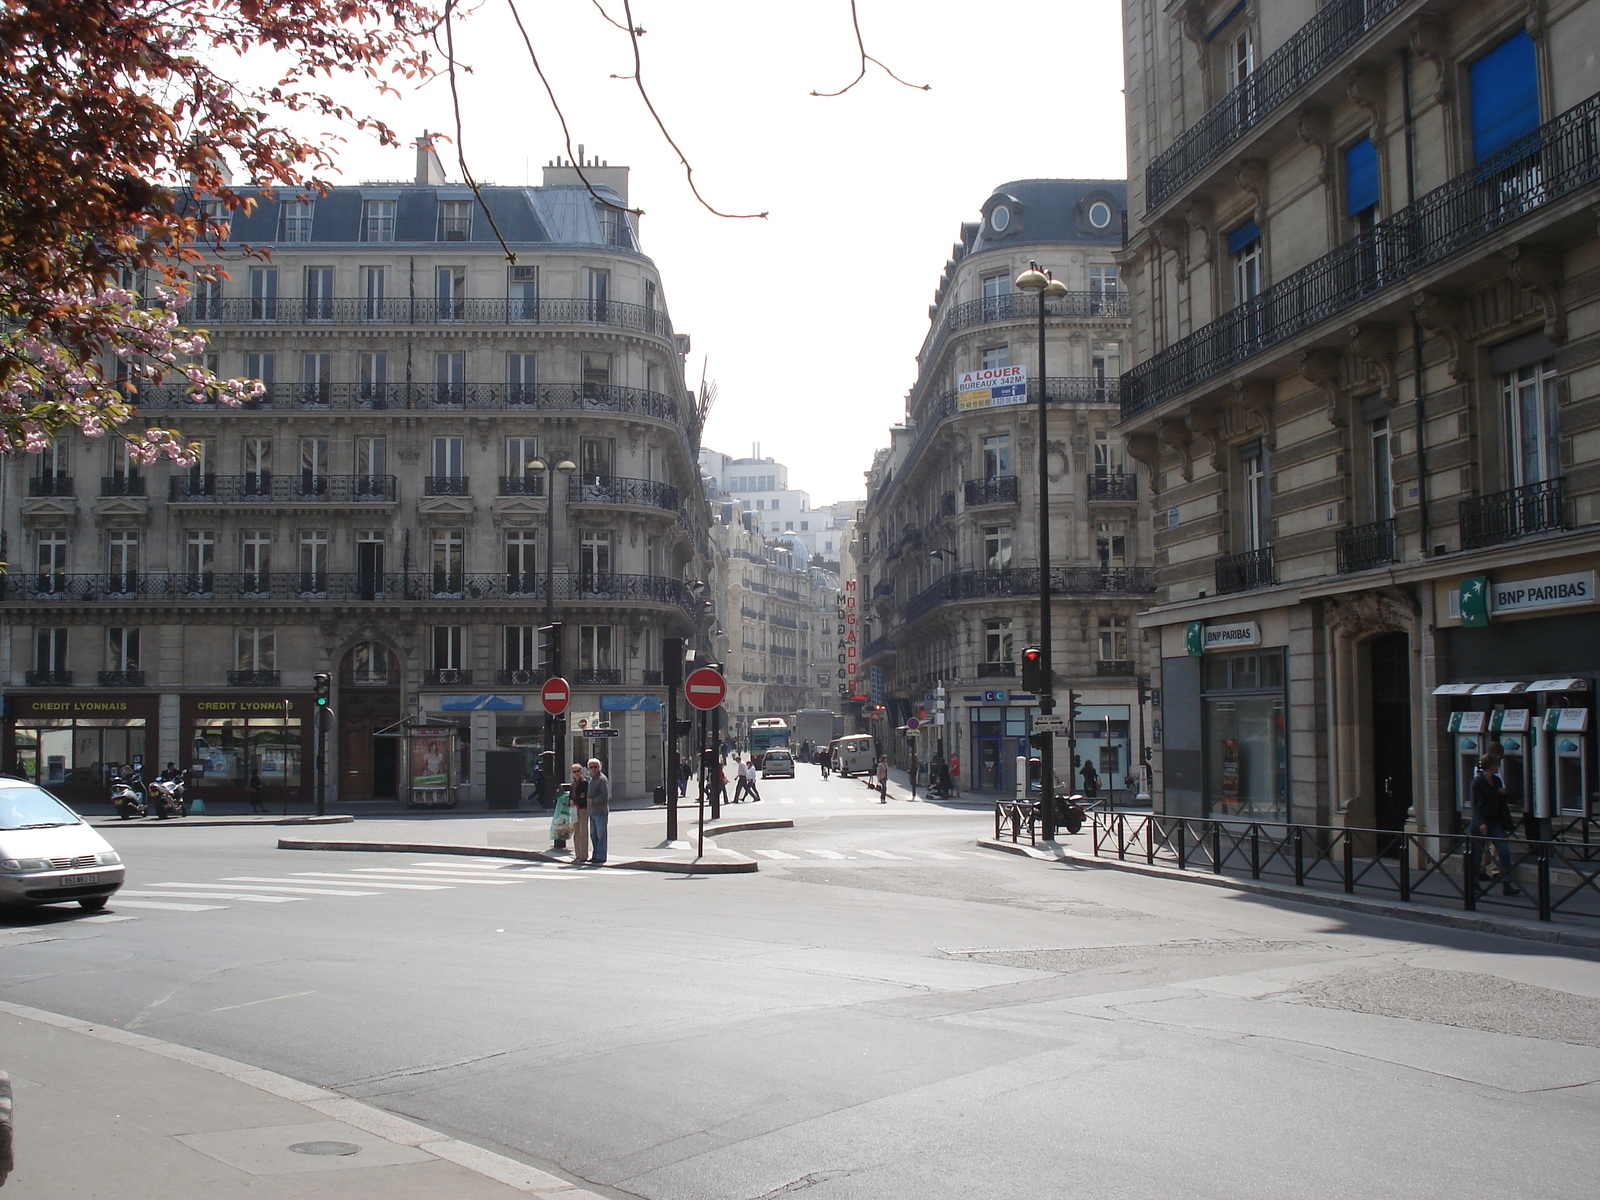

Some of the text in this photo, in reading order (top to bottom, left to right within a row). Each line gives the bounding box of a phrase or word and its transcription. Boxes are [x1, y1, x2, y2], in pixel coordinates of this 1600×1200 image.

[964, 367, 1021, 383] A LOUER
[960, 379, 998, 390] BUREAUX
[1498, 581, 1586, 606] BNP PARIBAS
[845, 580, 856, 691] MOGADOR
[1207, 628, 1251, 642] BNP PARIBAS
[32, 702, 127, 711] CREDIT LYONNAIS
[197, 702, 294, 710] CREDIT LYONNAIS
